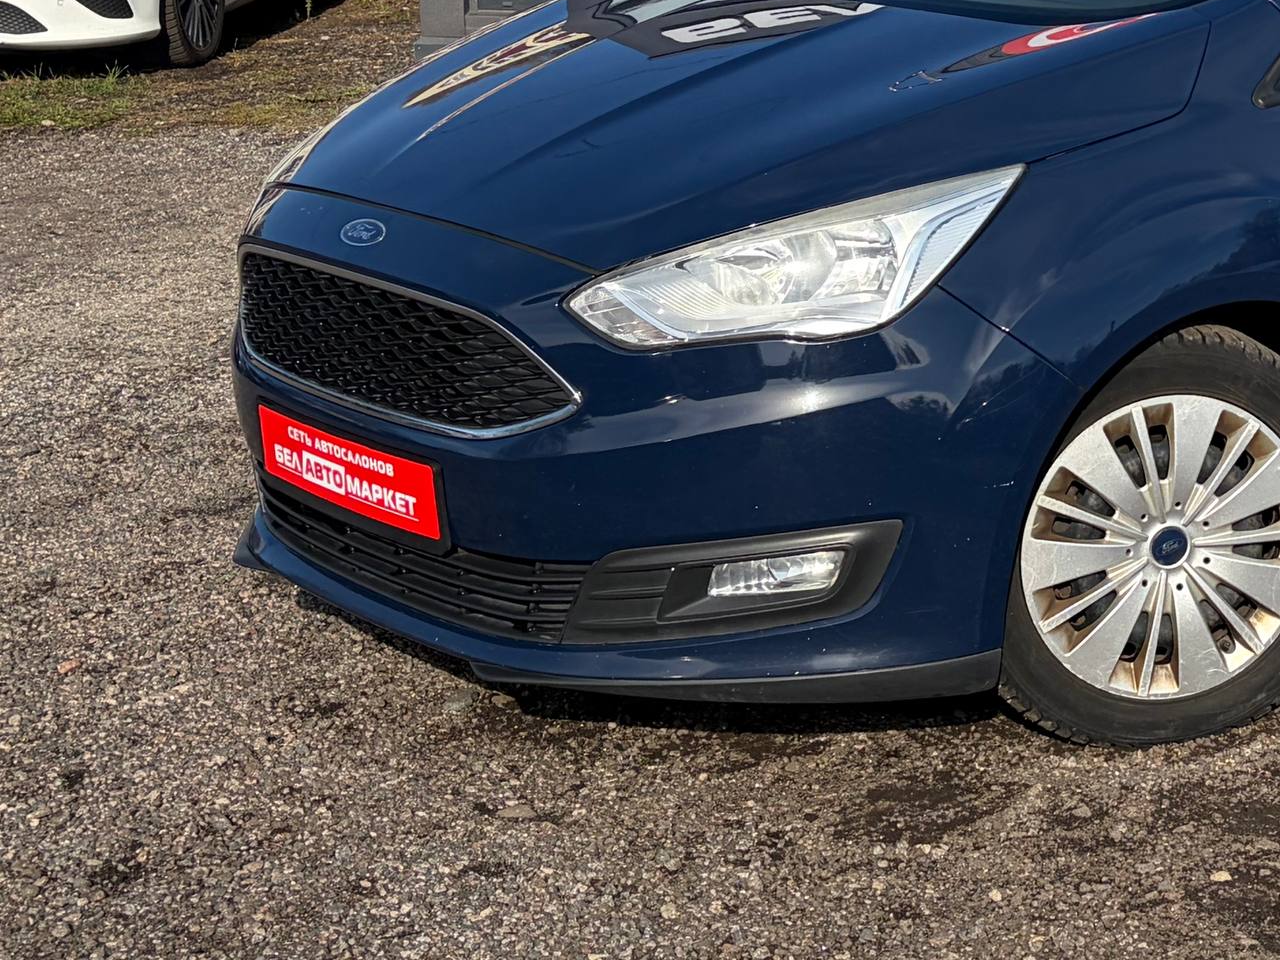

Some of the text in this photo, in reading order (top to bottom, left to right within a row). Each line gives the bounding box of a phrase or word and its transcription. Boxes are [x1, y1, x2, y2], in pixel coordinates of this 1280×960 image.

[274, 443, 417, 516] БЕЛ АВТО МАРКЕТ
[287, 426, 395, 477] СЕТЬ АВТОСАЛОНОВ
